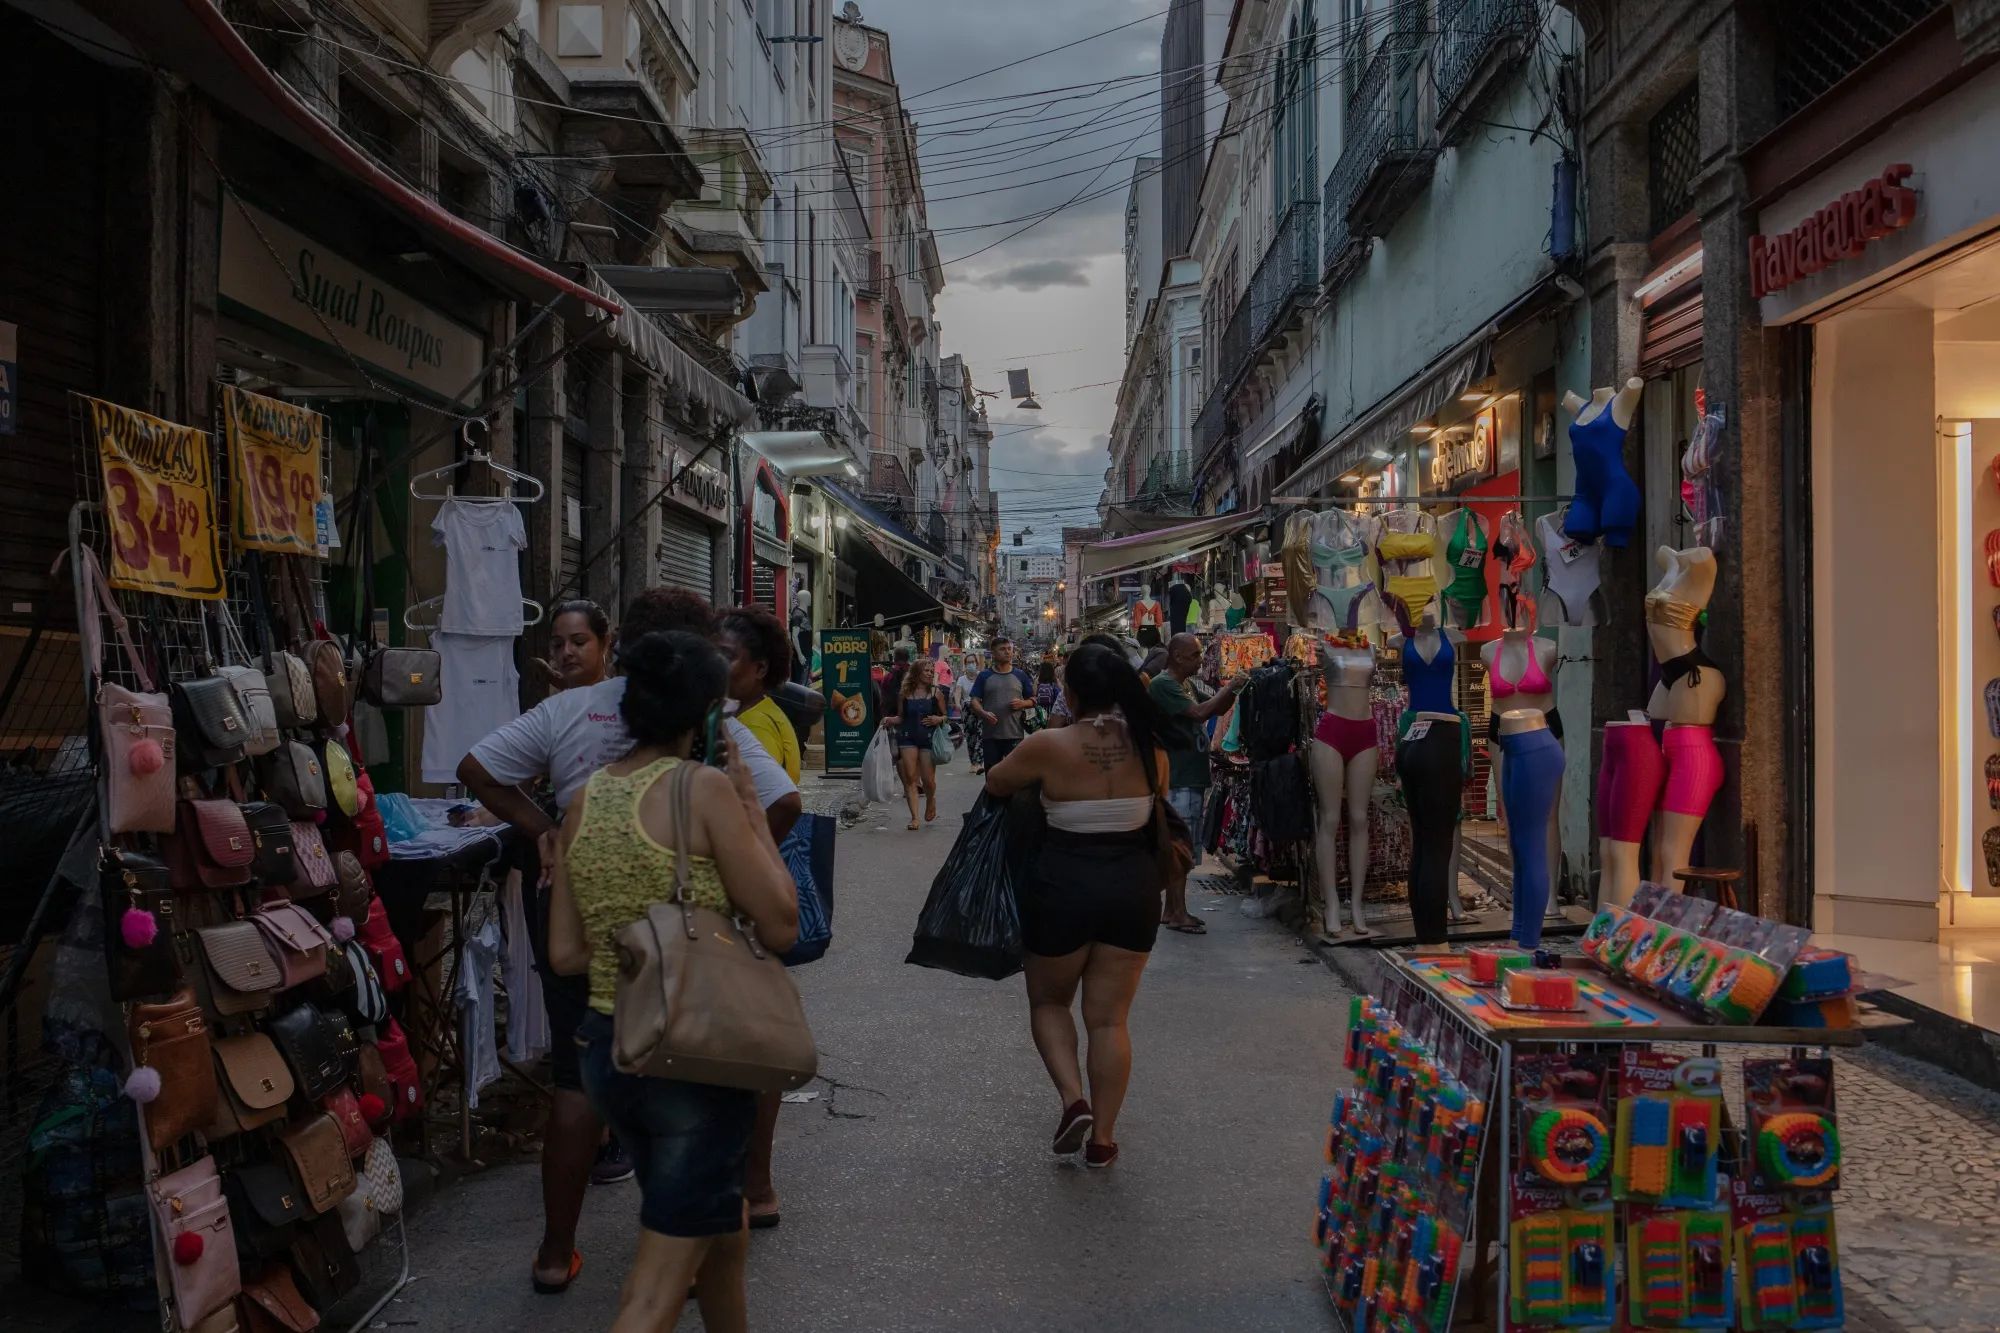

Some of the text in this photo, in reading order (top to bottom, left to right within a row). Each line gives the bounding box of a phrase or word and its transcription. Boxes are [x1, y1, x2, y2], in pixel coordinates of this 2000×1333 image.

[1749, 163, 1917, 298] havaianas
[293, 249, 443, 370] Suad Roupas
[824, 641, 867, 654] DOBRO
